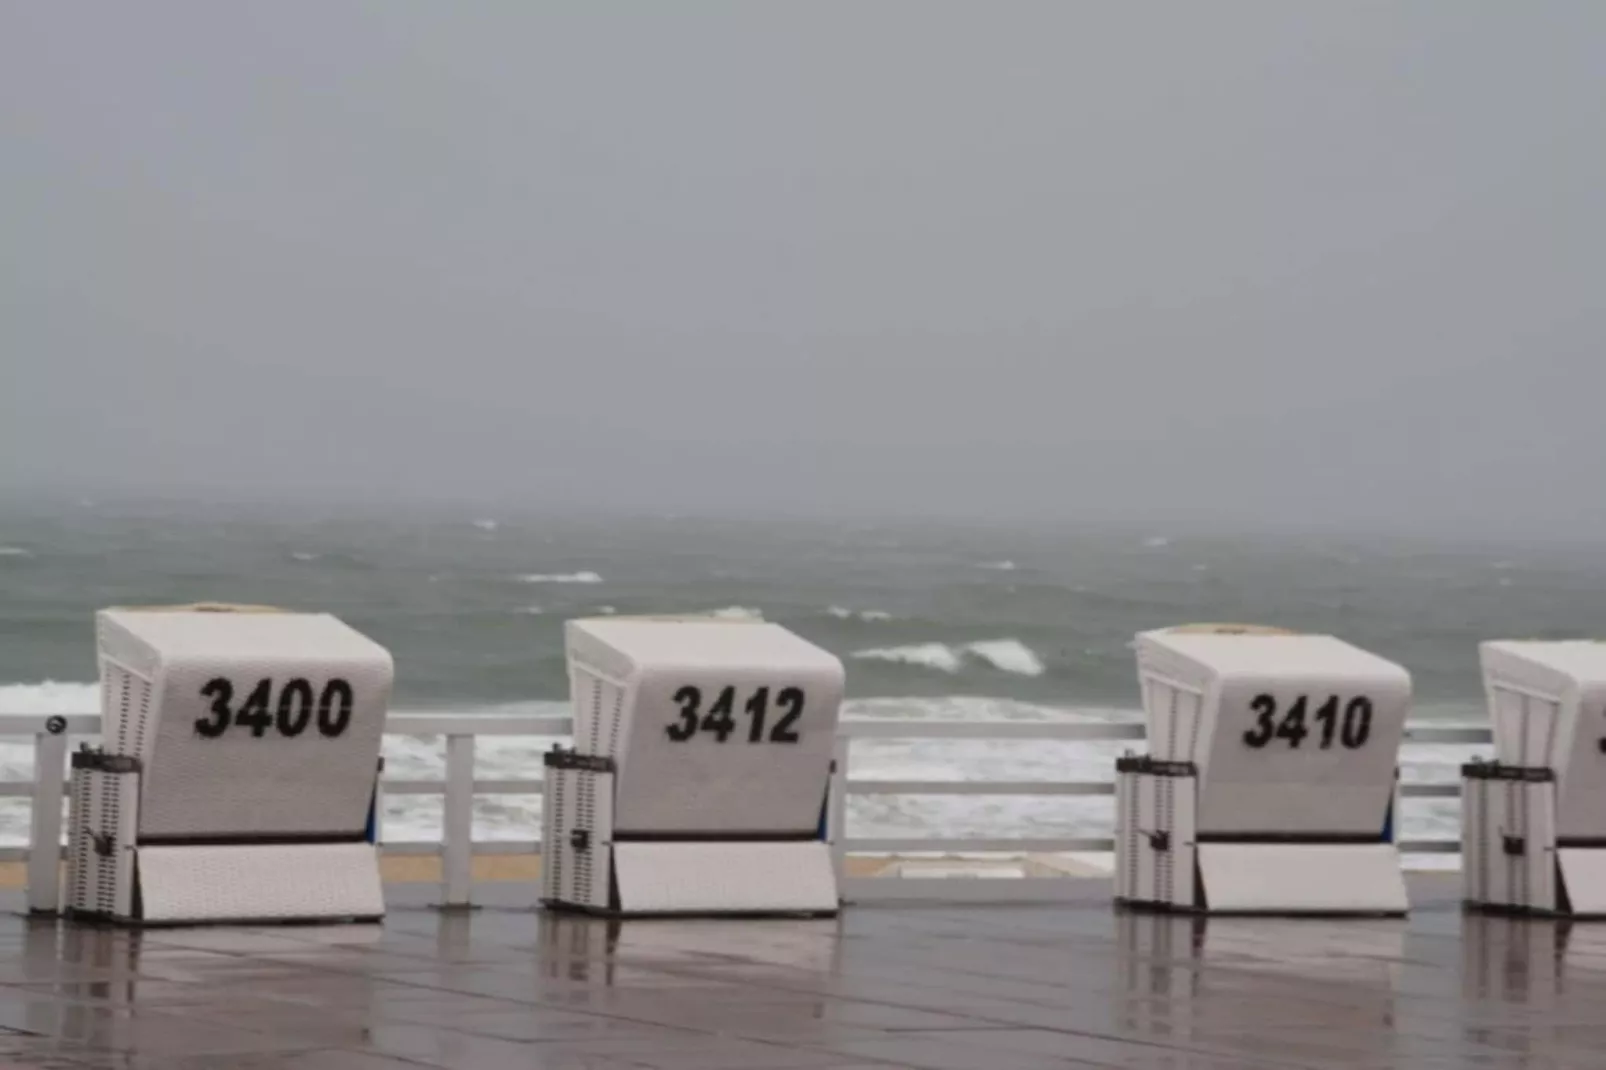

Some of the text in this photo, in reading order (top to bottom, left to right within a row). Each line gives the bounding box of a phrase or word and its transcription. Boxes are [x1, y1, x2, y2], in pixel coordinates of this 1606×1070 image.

[194, 676, 354, 739] 3400
[665, 684, 805, 743] 3412
[1242, 692, 1373, 749] 3410
